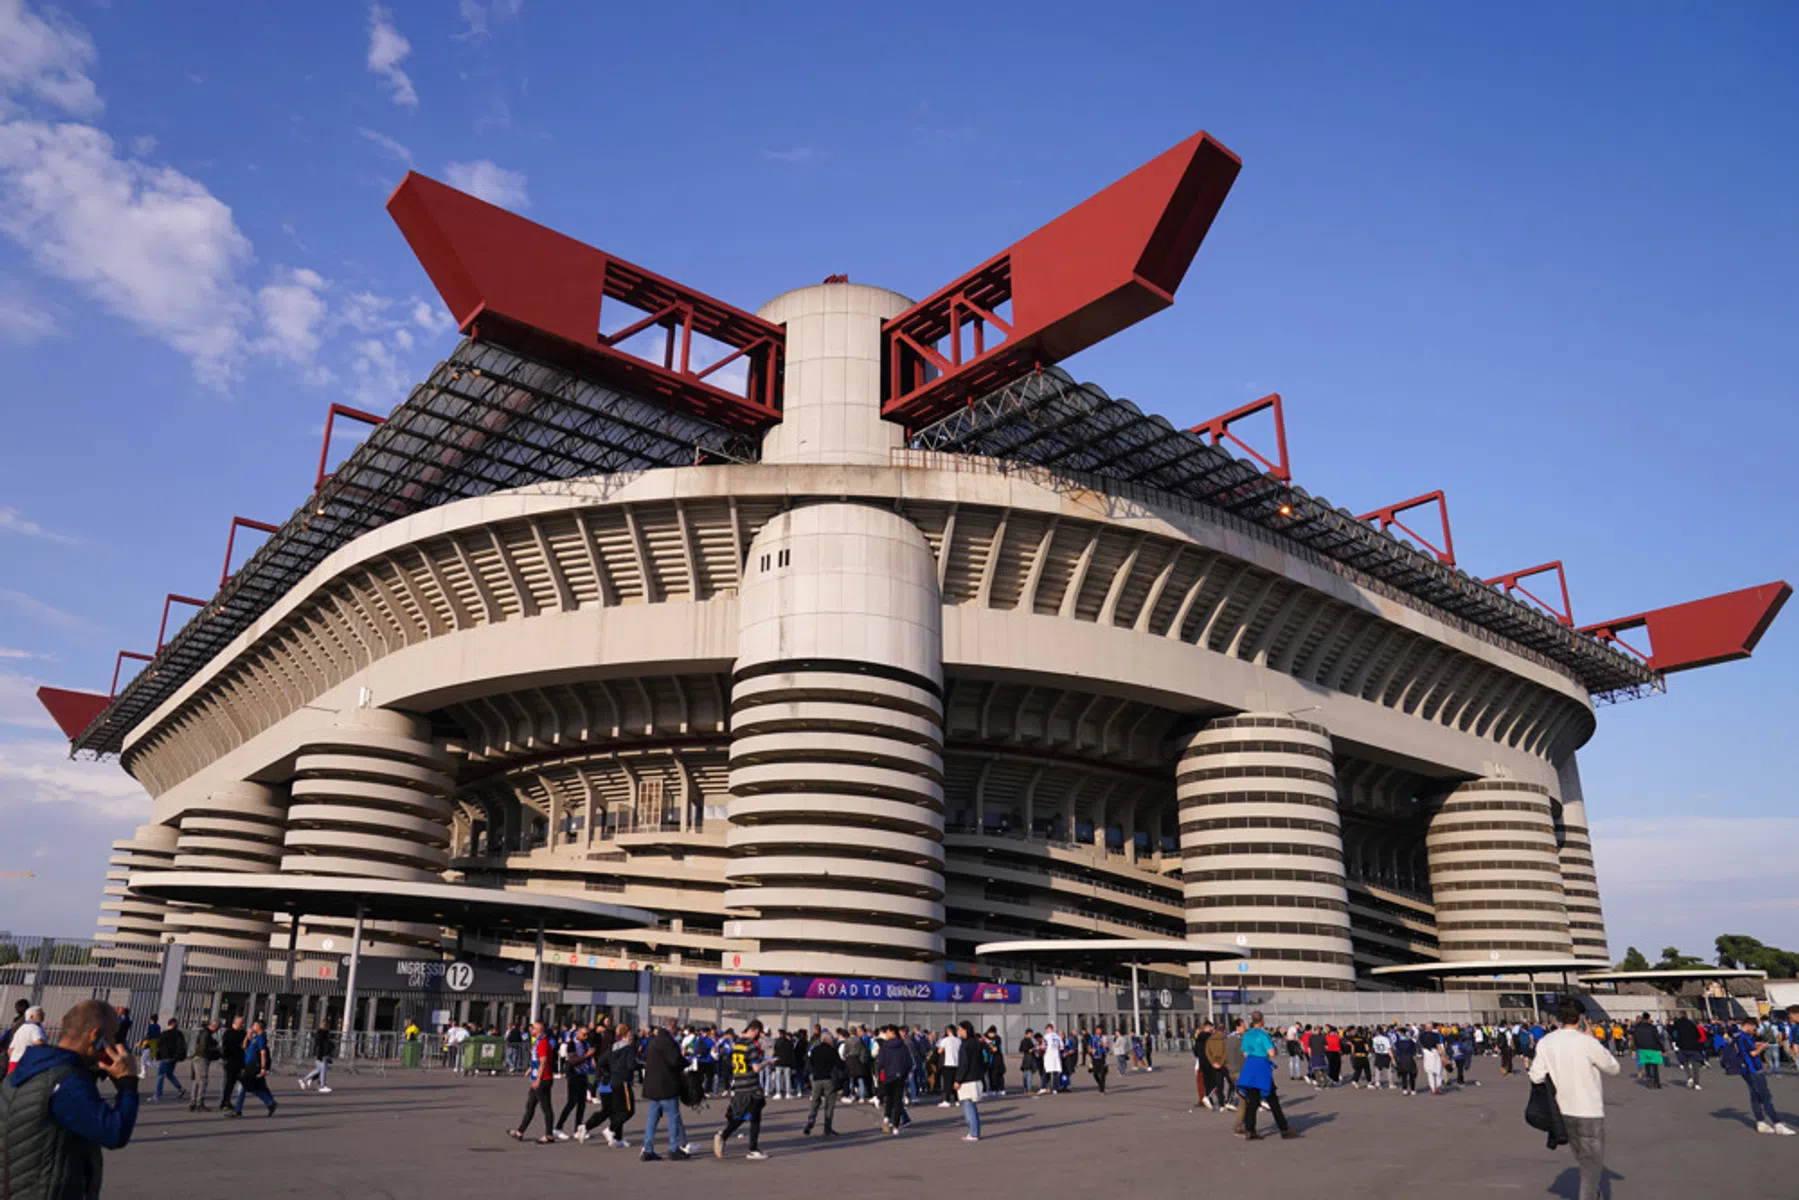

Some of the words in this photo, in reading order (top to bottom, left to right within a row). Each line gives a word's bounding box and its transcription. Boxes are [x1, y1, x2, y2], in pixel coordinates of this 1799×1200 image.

[396, 960, 445, 976] INGRESSO
[451, 965, 469, 987] 12
[408, 974, 431, 988] GATE
[817, 982, 858, 996] ROAD
[865, 984, 881, 996] TO
[732, 1053, 747, 1074] 33
